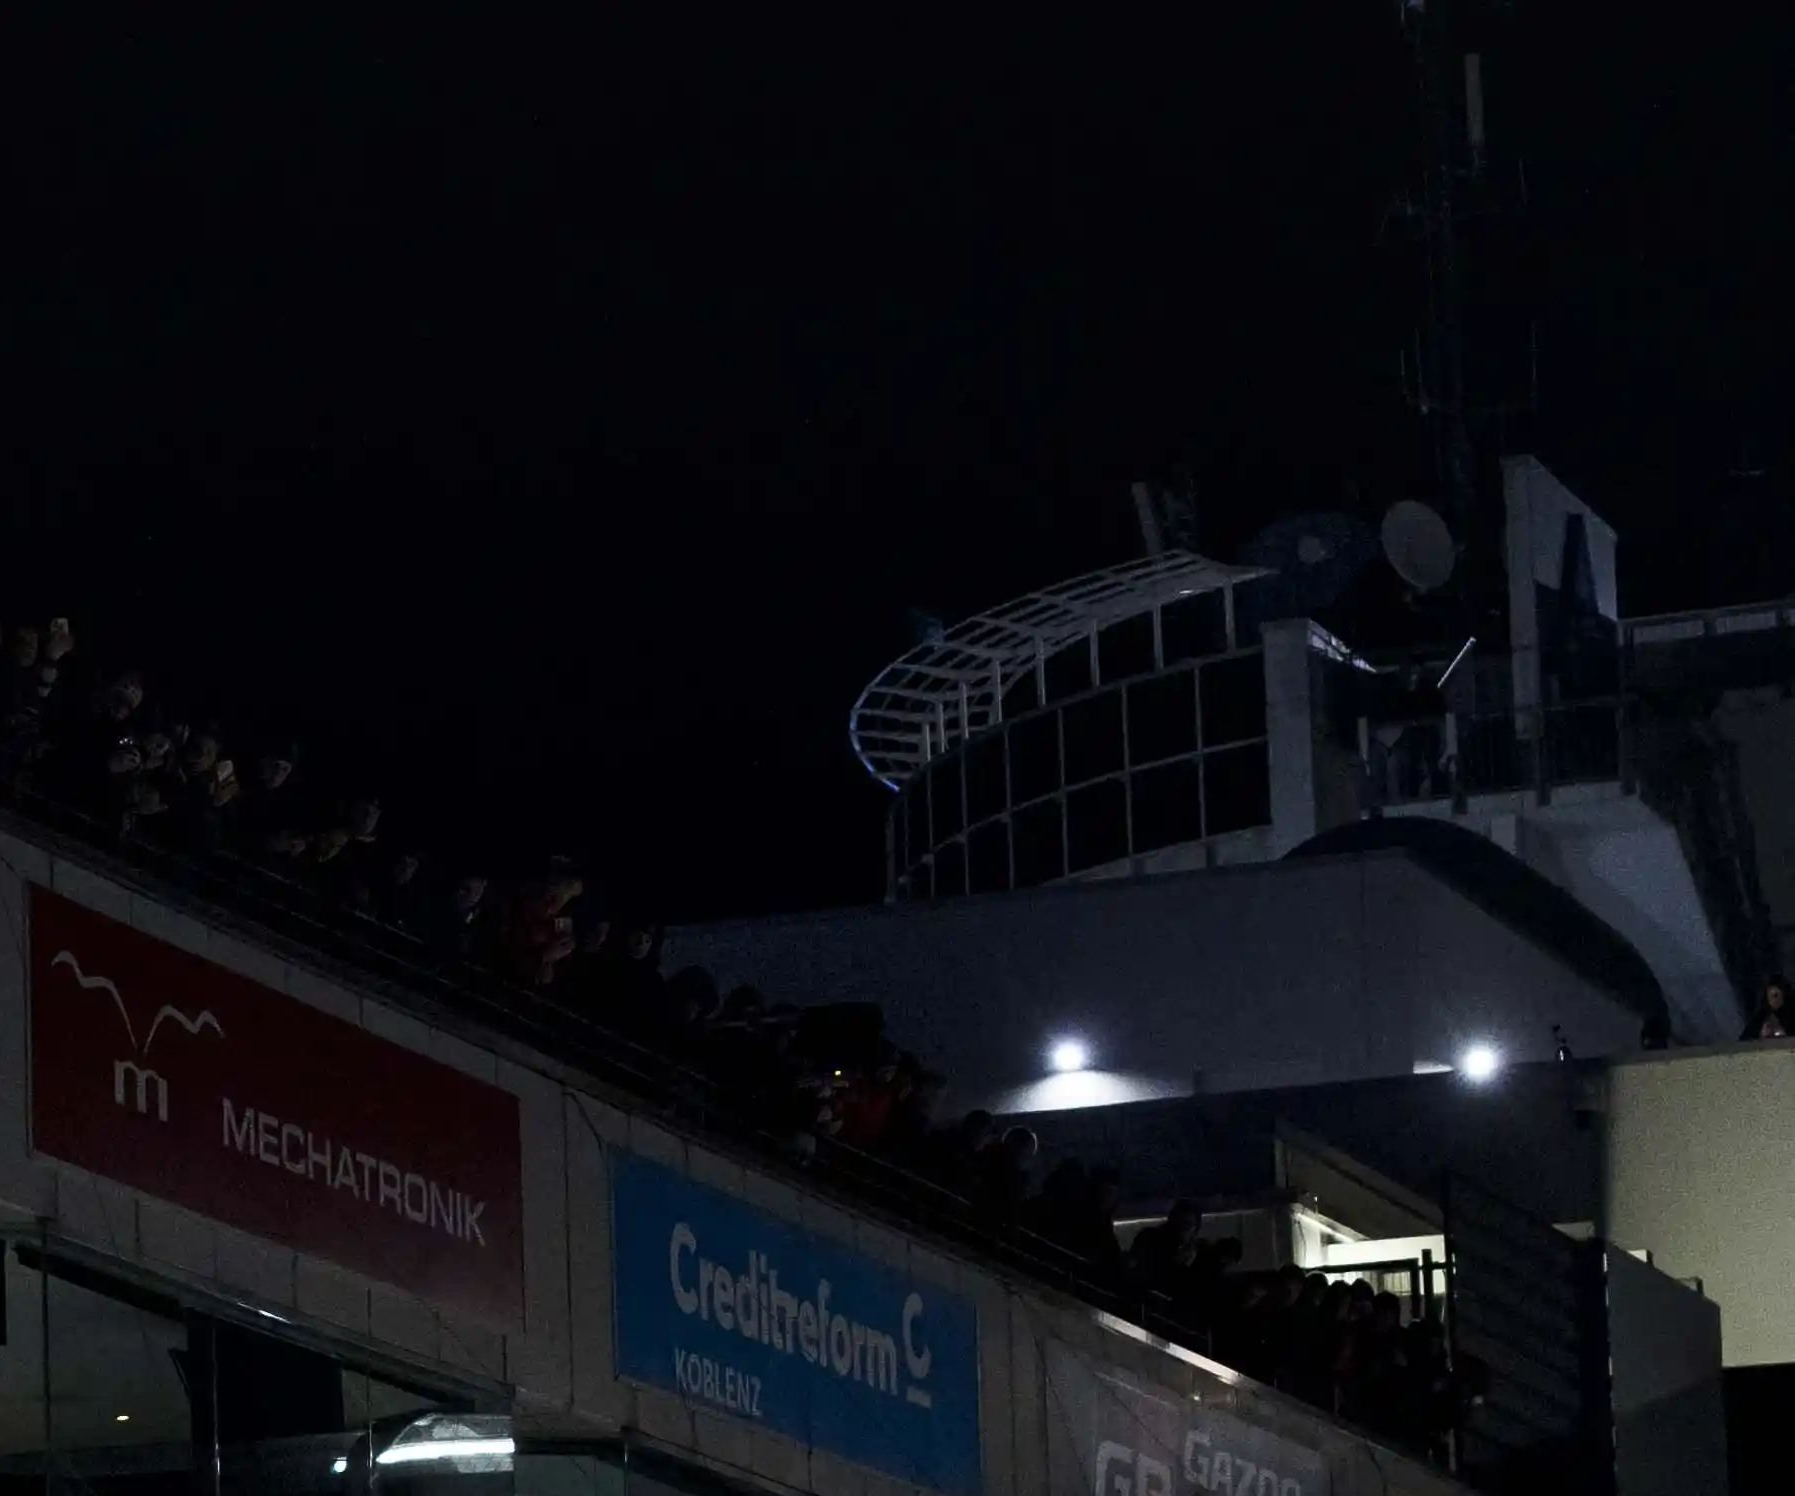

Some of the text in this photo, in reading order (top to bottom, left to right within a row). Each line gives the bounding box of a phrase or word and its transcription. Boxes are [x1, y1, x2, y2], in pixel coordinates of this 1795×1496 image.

[221, 1095, 487, 1248] MECHATRONIK
[669, 1221, 899, 1399] Creditreform
[673, 1347, 763, 1417] KOBLENZ
